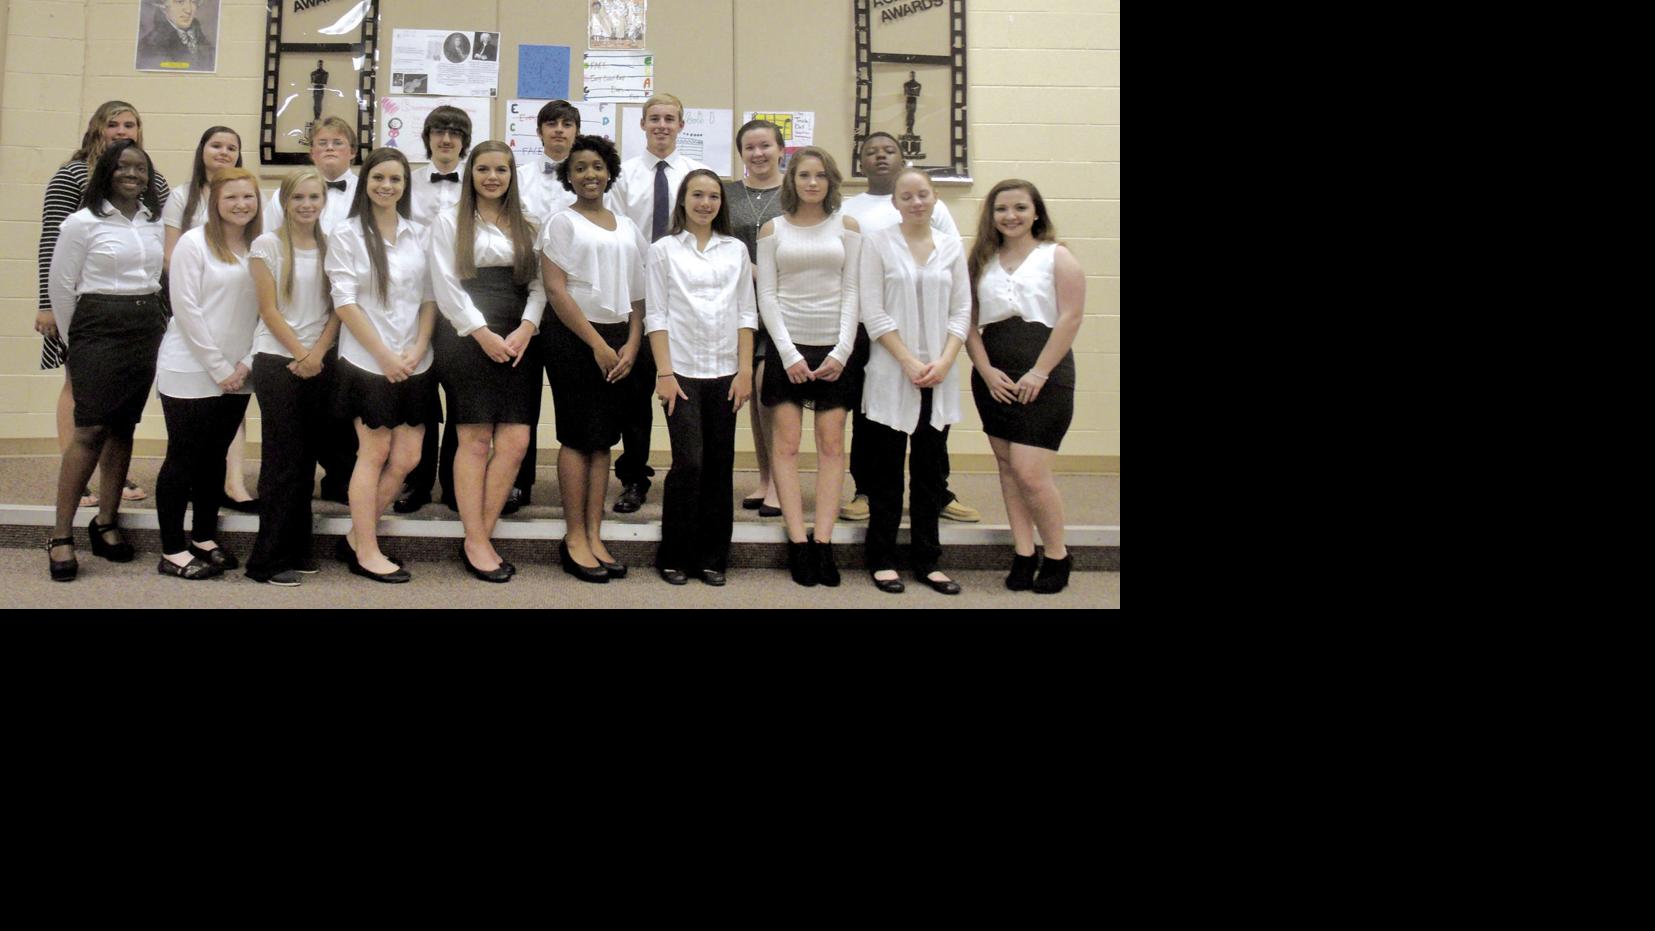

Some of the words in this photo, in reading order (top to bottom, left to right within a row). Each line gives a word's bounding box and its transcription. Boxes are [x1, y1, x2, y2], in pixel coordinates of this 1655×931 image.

[881, 0, 944, 23] AWARDS
[511, 103, 519, 114] E
[602, 116, 610, 125] D
[510, 122, 516, 132] C
[509, 138, 516, 147] A
